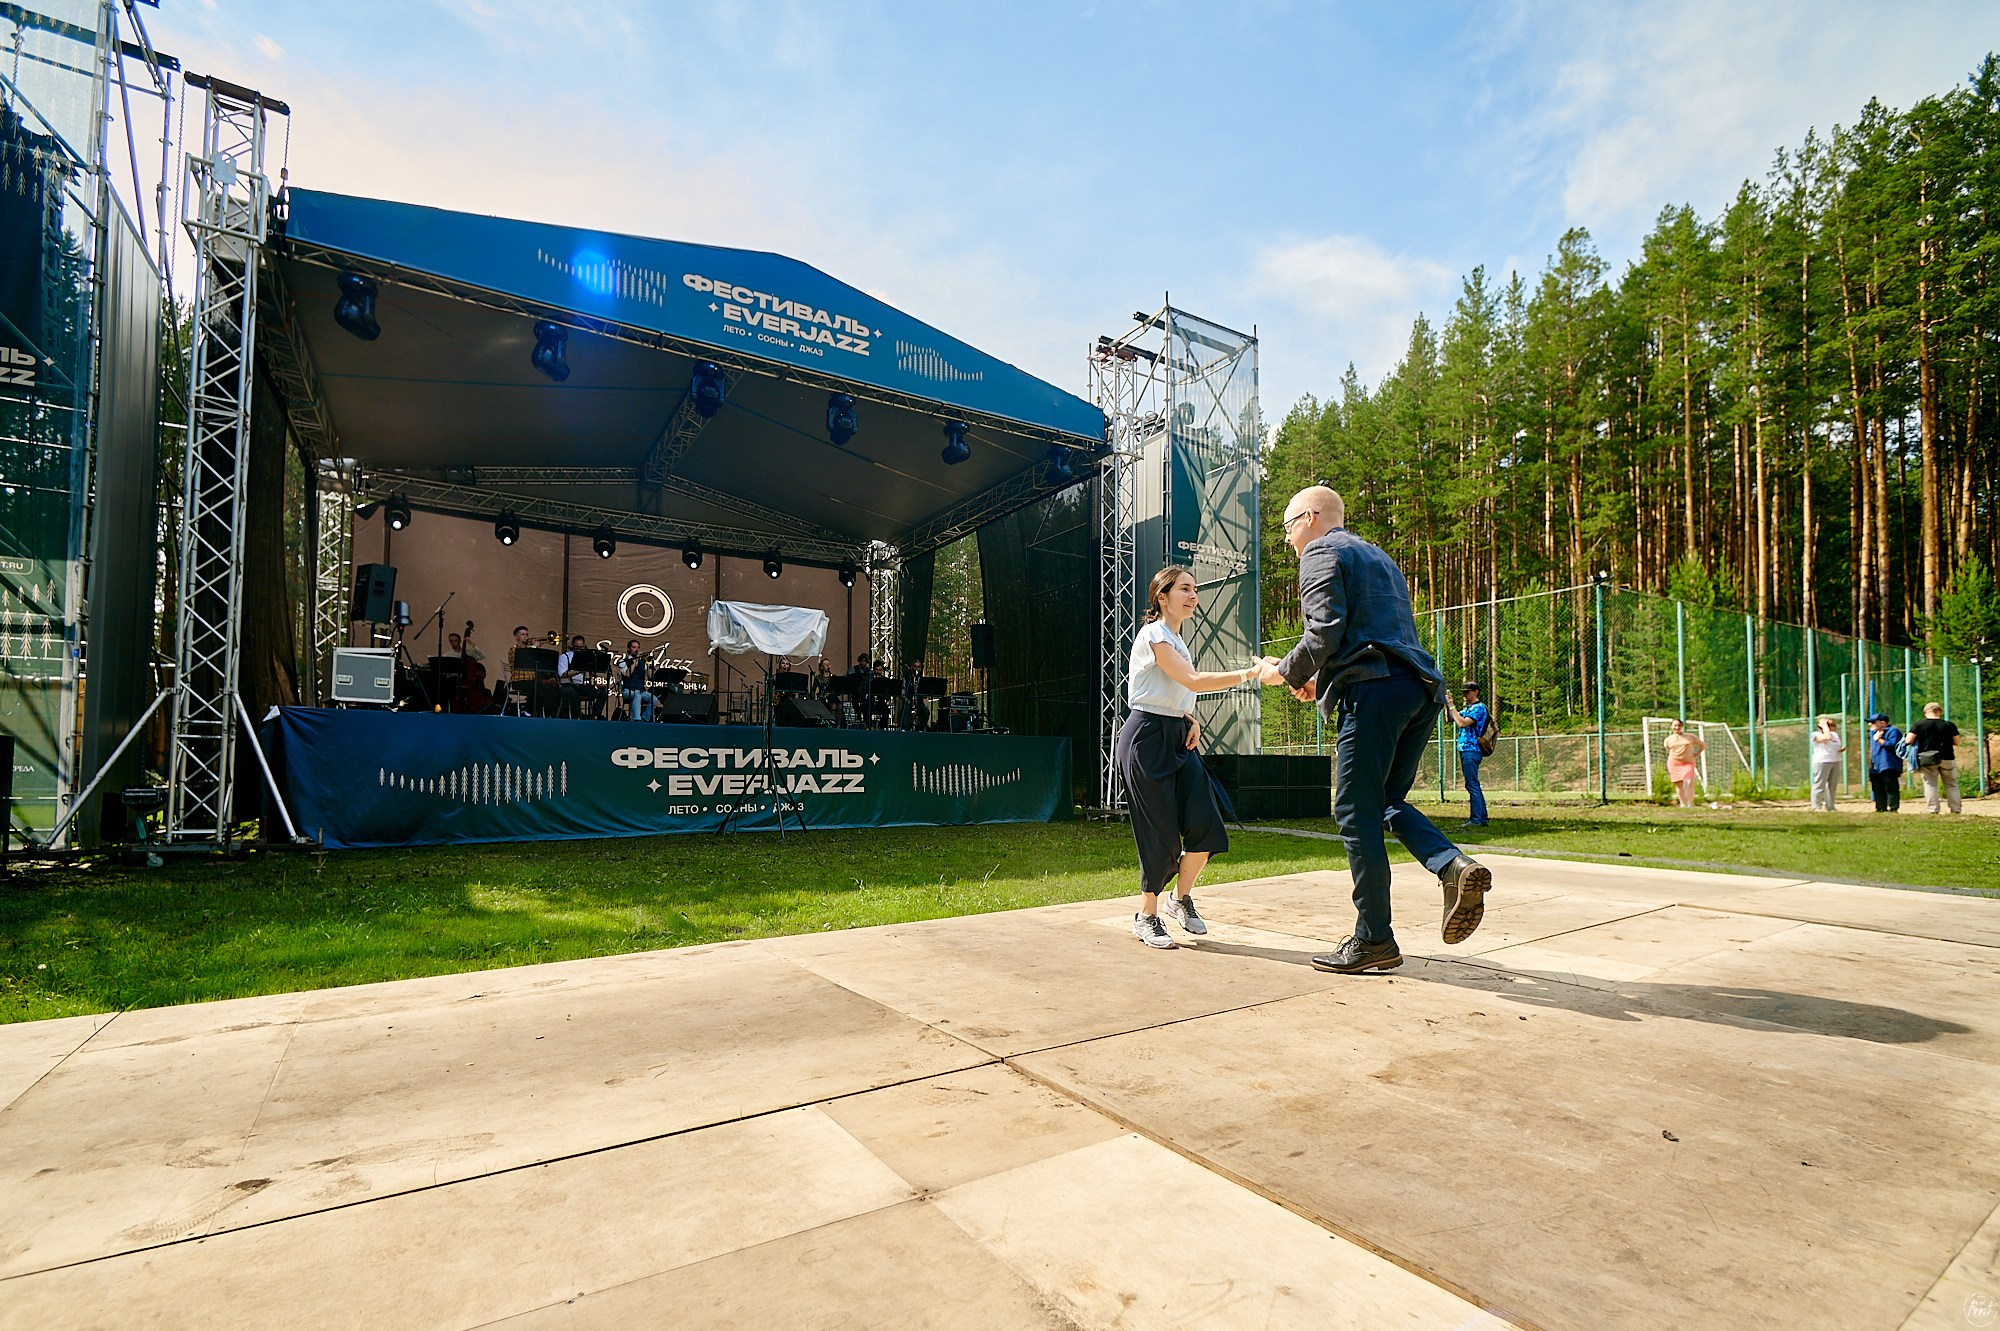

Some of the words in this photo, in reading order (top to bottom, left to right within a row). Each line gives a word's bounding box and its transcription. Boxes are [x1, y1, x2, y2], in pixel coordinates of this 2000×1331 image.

[683, 273, 870, 337] ФЕСТИВАЛЬ
[723, 303, 870, 356] EVERJAZZ
[723, 324, 746, 336] ЛЕТО
[757, 333, 789, 347] СОСНЫ
[799, 344, 824, 357] ДЖАЗ
[1177, 541, 1248, 562] ФЕСТИВАЛЬ
[1194, 553, 1248, 572] EVERJAZZ
[611, 747, 864, 768] ФЕСТИВАЛЬ
[668, 774, 865, 795] EVERJAZZ
[668, 804, 699, 815] ЛЕТО
[716, 803, 757, 814] СОНЫ
